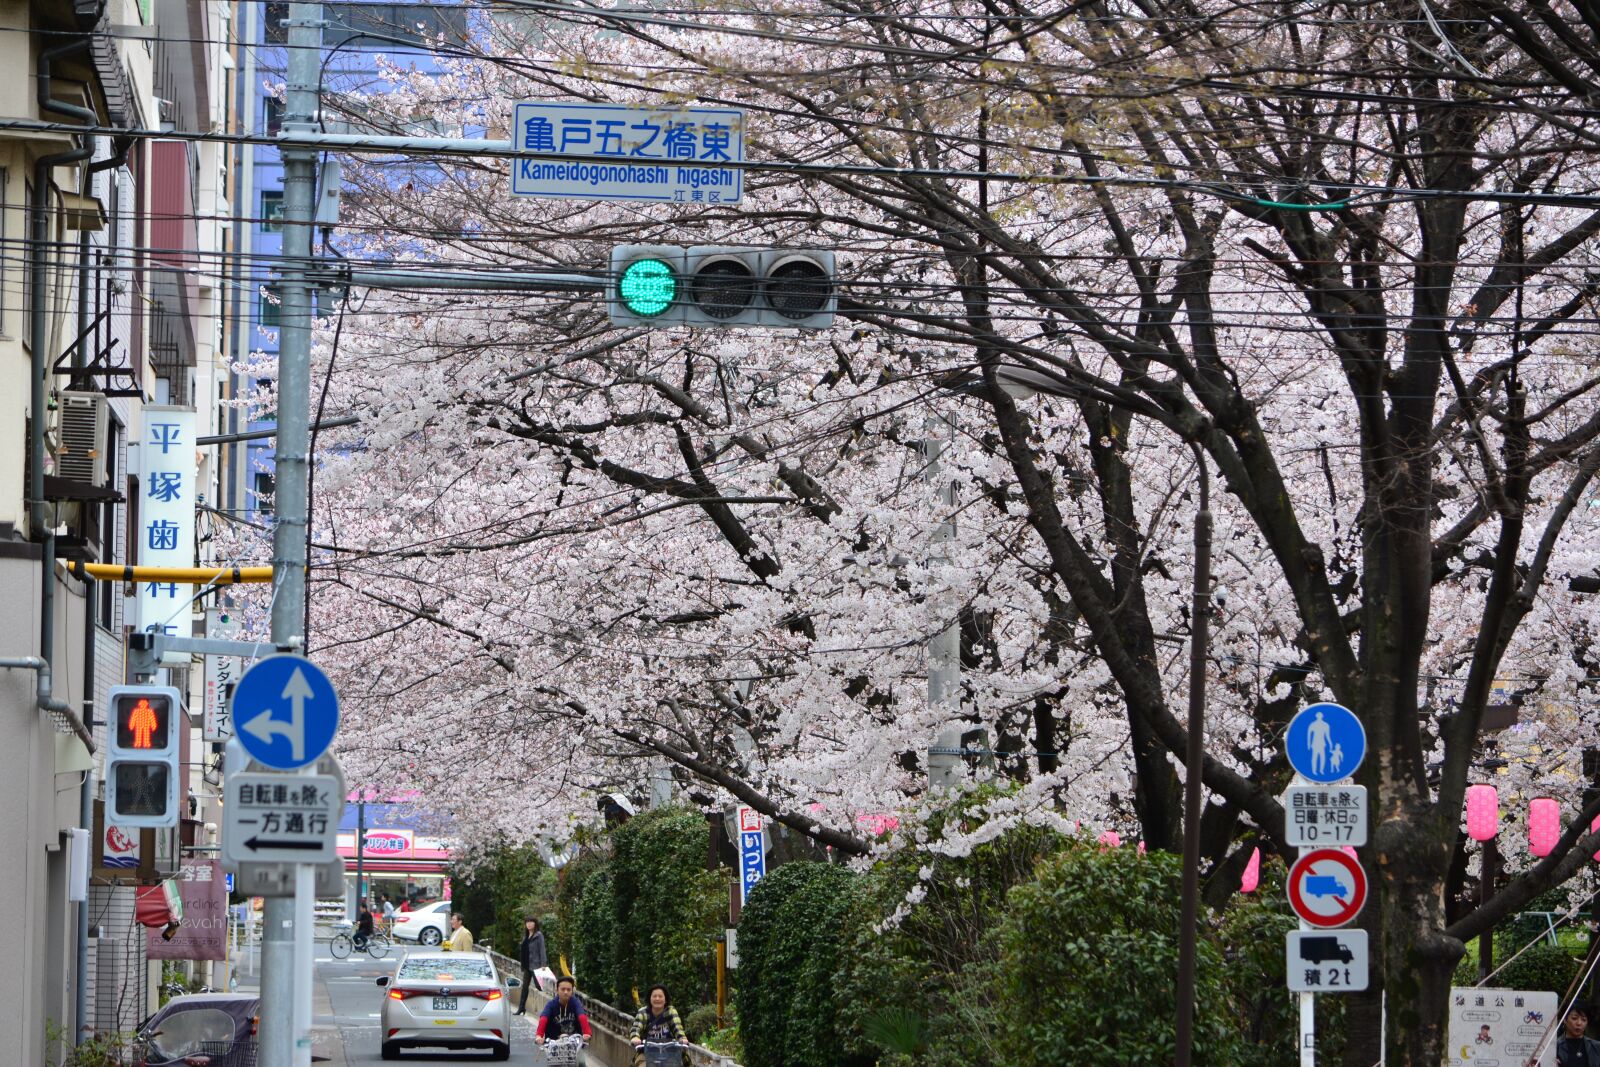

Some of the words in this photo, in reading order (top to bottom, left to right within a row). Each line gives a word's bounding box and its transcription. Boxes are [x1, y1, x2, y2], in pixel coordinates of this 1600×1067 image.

[524, 116, 732, 162] 亀戸五之橋東
[521, 158, 668, 185] Kameidogonohashi
[677, 168, 733, 188] higashi
[673, 189, 722, 202] 江東区
[239, 784, 329, 806] 自転車を除く
[1293, 791, 1359, 807] 自転車を除く
[238, 811, 328, 835] 一方通行
[1295, 809, 1358, 824] 日曜・休日の
[1299, 826, 1353, 841] 10-17
[744, 834, 761, 893] いづみ
